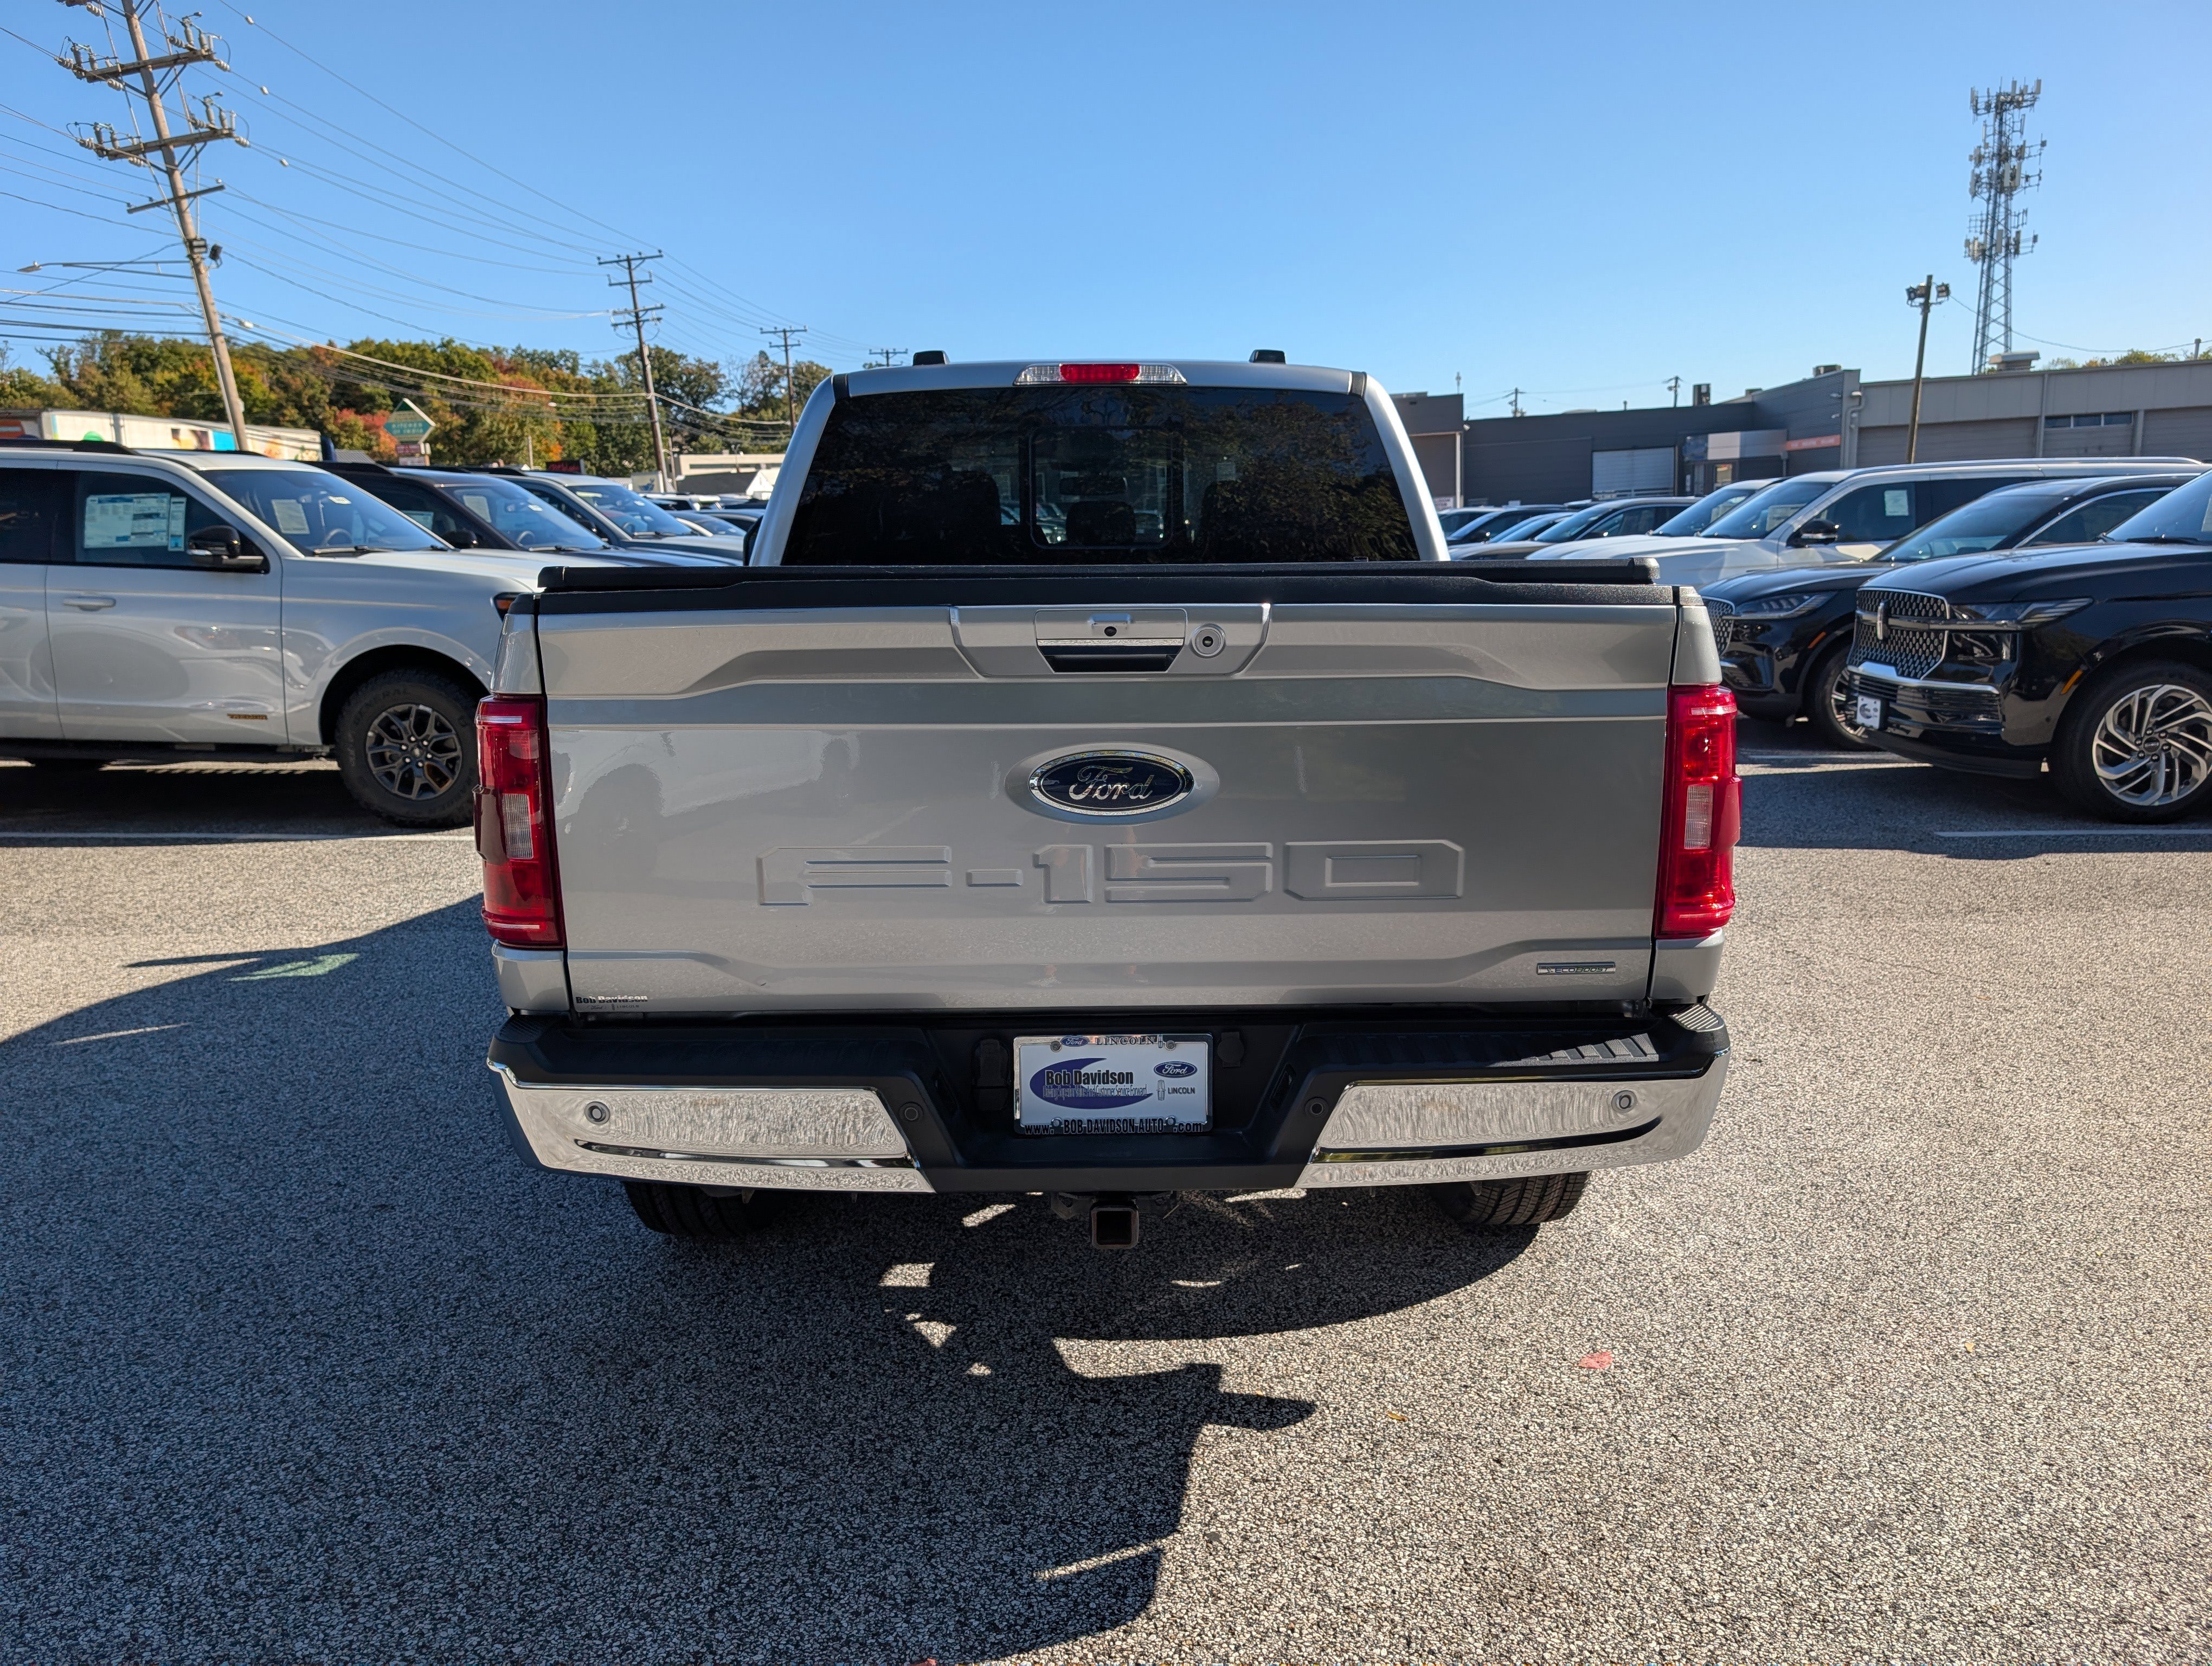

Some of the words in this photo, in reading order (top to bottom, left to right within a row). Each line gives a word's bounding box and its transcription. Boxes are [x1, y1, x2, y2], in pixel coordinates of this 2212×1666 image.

[1069, 765, 1154, 800] Ford
[757, 840, 1463, 906] F-150
[575, 996, 596, 1004] Bob
[597, 995, 648, 1003] Davidson
[1065, 1037, 1083, 1045] Ford
[1095, 1036, 1155, 1046] LINCOLN
[1162, 1063, 1188, 1074] Ford
[1045, 1069, 1071, 1085] Bob
[1073, 1069, 1134, 1085] Davidson
[1096, 1085, 1115, 1097] Customer
[1115, 1085, 1129, 1097] Service
[1130, 1084, 1147, 1097] Forward
[1063, 1119, 1084, 1135] BOB
[1086, 1118, 1135, 1134] DAVIDSON
[1139, 1118, 1163, 1133] AUTO
